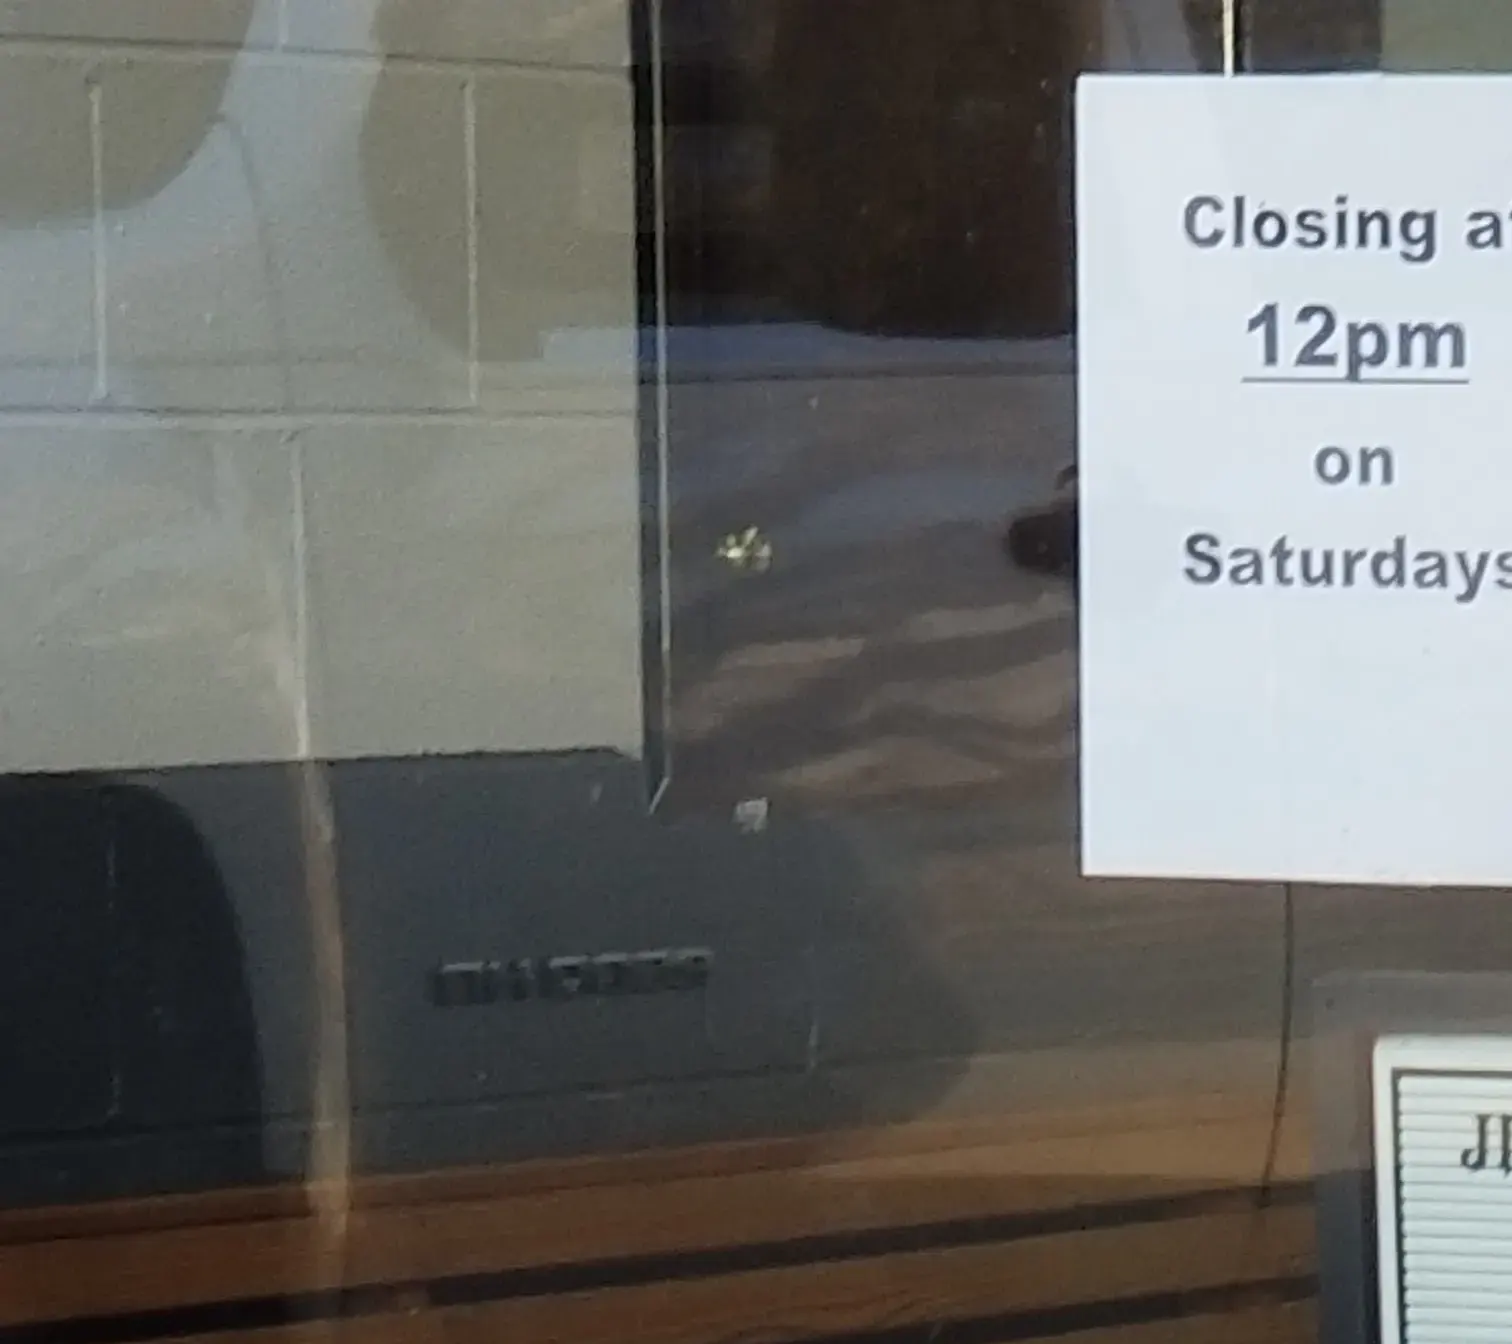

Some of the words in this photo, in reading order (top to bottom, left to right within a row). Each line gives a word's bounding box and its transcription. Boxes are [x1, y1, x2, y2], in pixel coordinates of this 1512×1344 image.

[1184, 195, 1437, 263] Closing
[1246, 303, 1466, 379] 12pm
[1315, 444, 1393, 486] on
